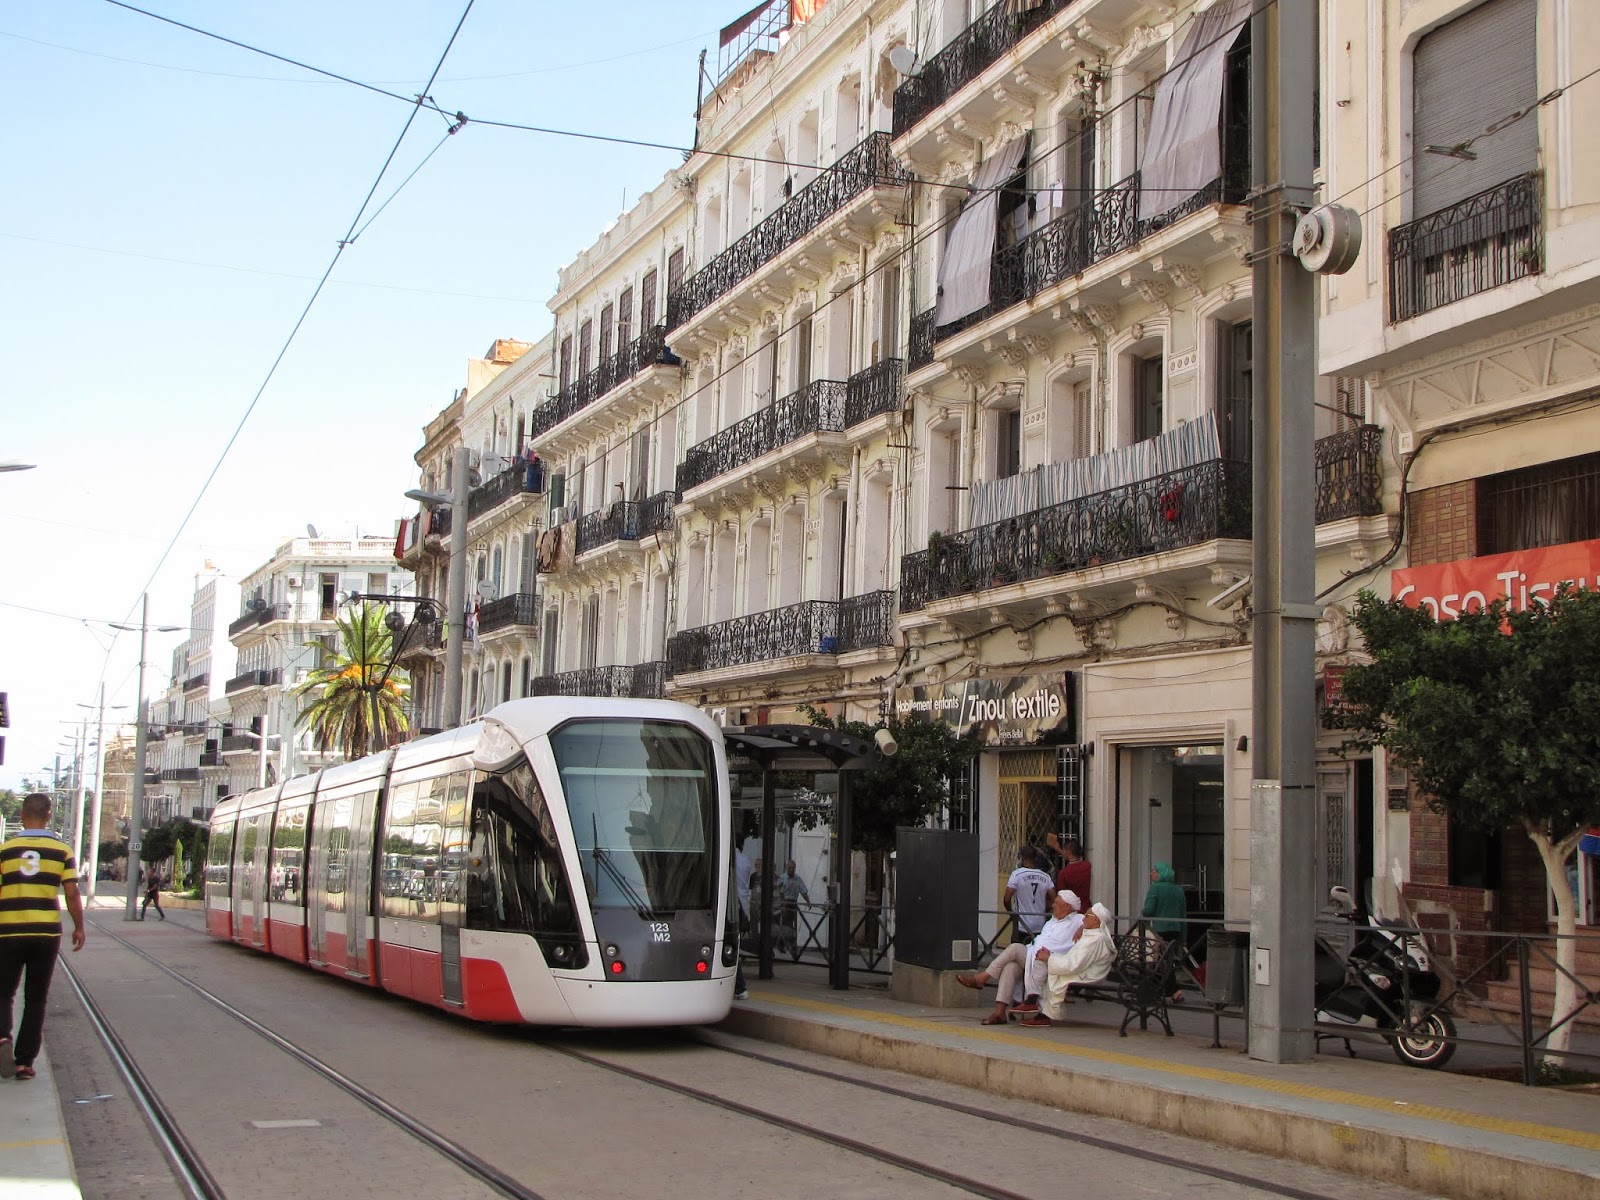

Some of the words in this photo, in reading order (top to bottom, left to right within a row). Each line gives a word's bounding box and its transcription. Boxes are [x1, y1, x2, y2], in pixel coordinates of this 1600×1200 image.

[934, 695, 960, 710] enfants
[968, 694, 1006, 722] Zinou
[1012, 688, 1060, 719] textile
[19, 850, 42, 876] 3
[1030, 882, 1039, 896] 7
[650, 923, 669, 932] 123
[653, 933, 671, 942] M2
